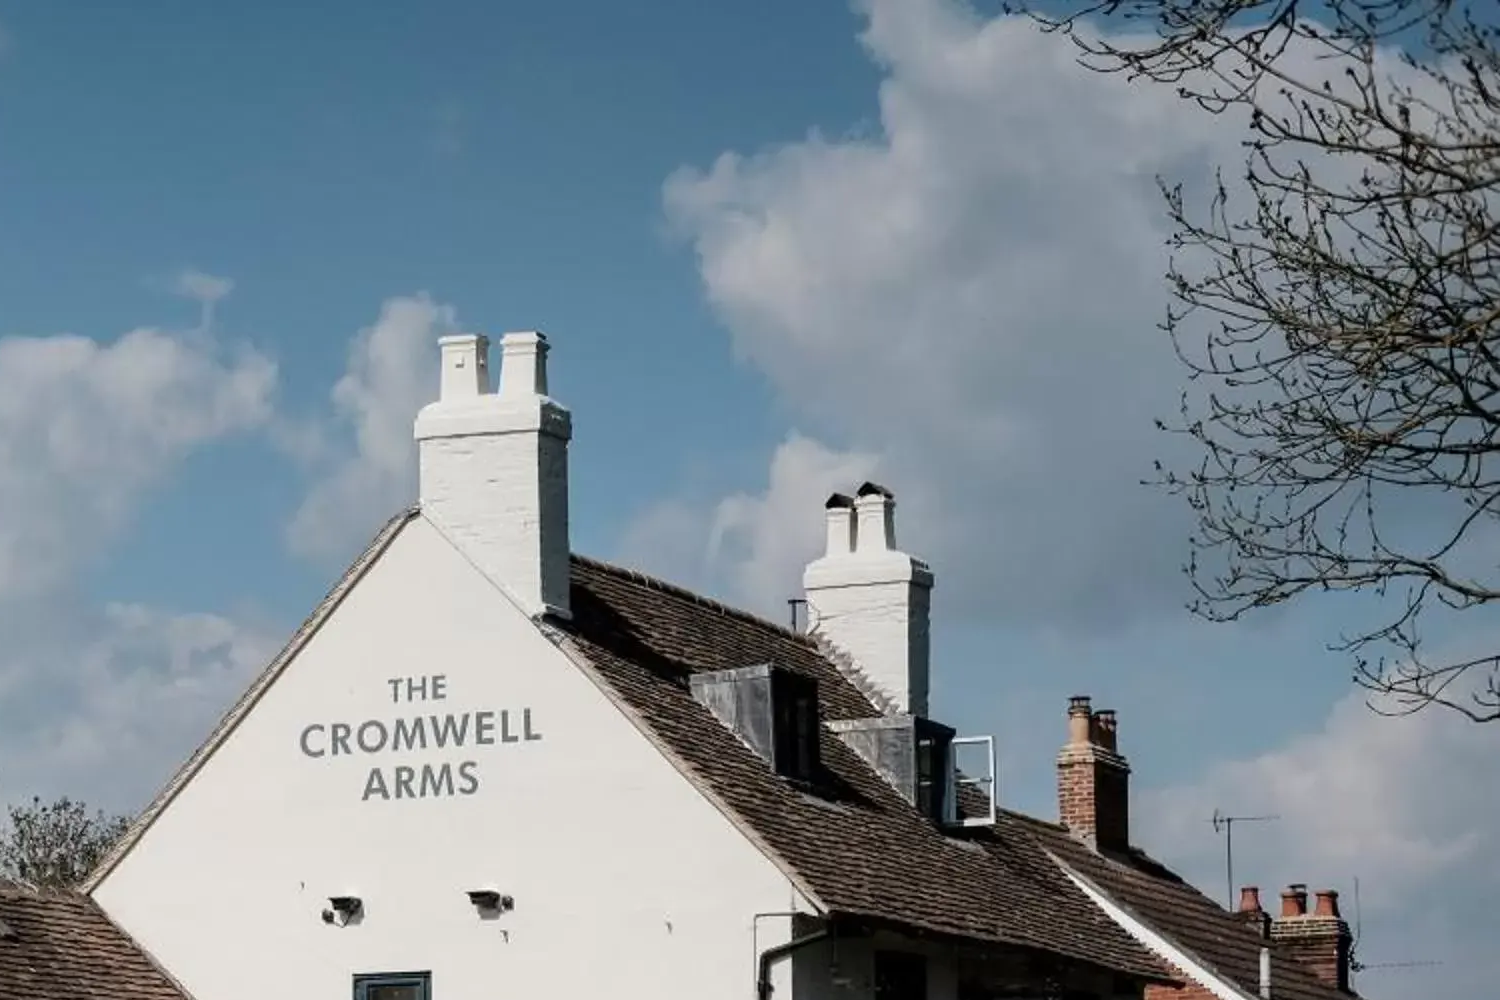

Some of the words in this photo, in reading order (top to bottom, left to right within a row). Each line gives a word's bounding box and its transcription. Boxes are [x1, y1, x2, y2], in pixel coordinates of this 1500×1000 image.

[387, 674, 447, 703] THE
[299, 707, 543, 758] CROMWELL
[361, 760, 480, 801] ARMS
